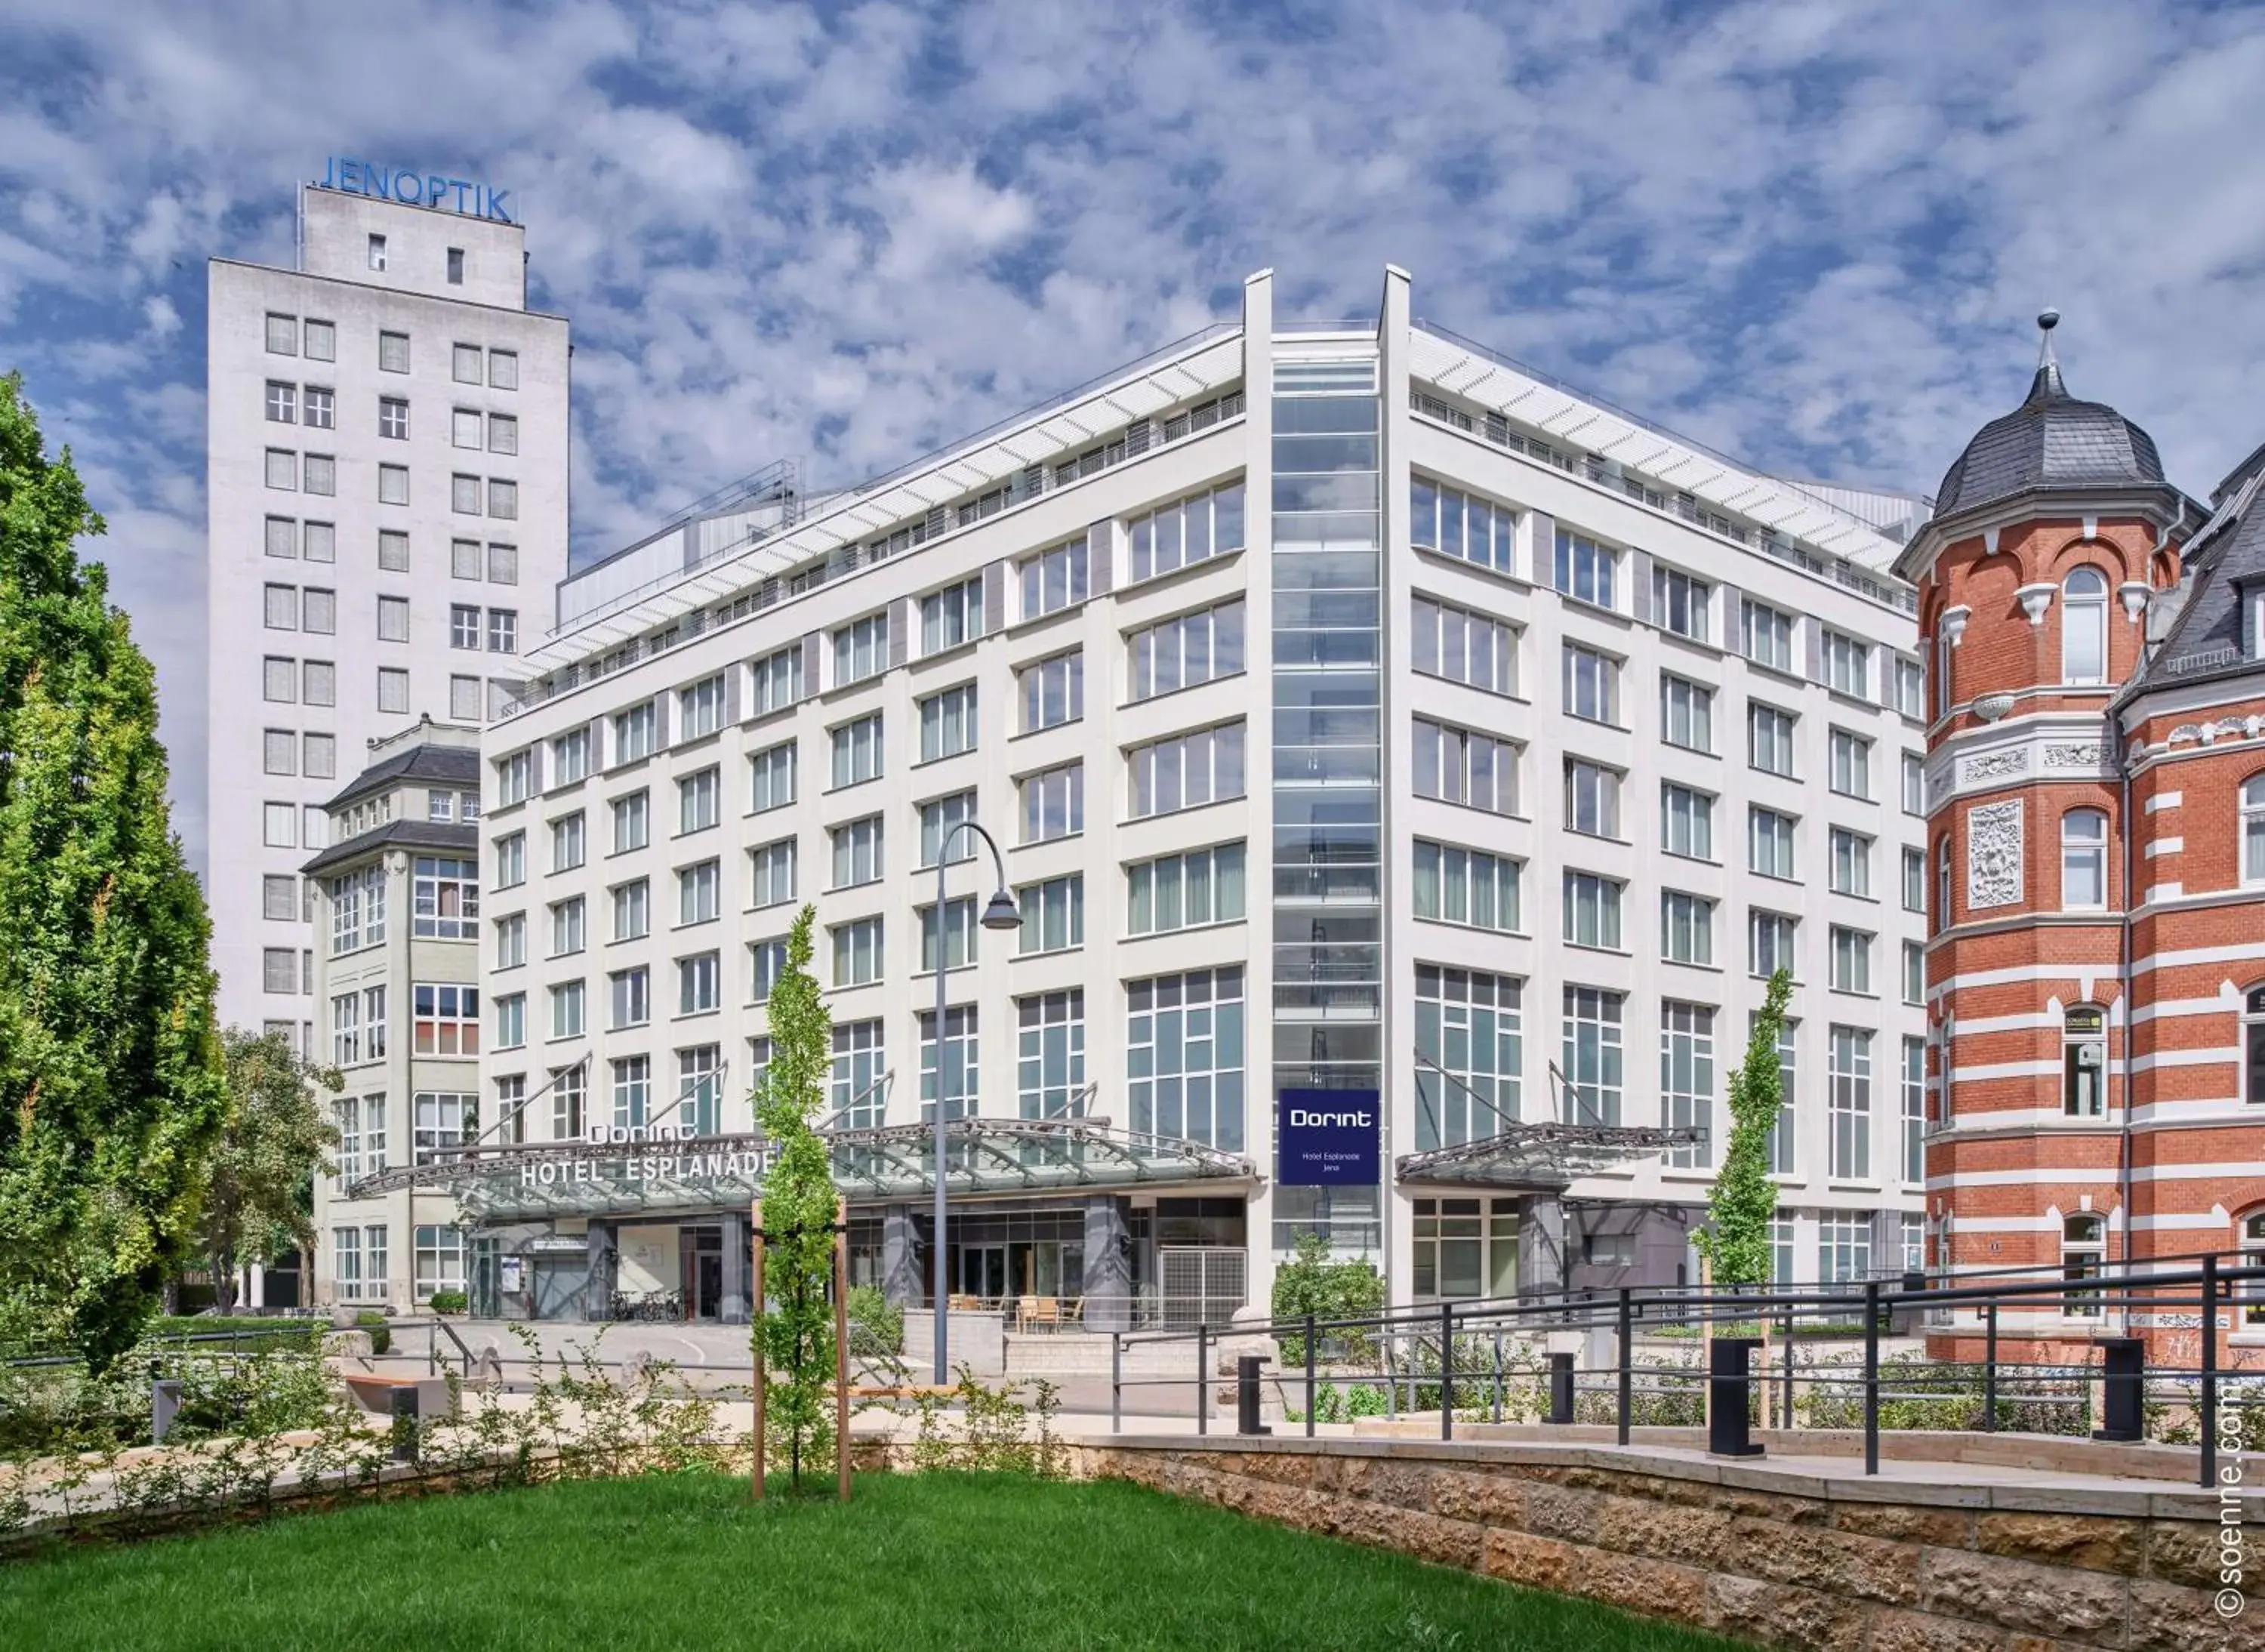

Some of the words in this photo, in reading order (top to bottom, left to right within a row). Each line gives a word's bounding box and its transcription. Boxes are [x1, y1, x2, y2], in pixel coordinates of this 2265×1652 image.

[320, 156, 512, 223] JENOPTIK
[1290, 1109, 1372, 1127] Dorint
[587, 1123, 698, 1145] Dorint
[1302, 1151, 1322, 1160] Hotel
[522, 1160, 602, 1186] HOTEL
[627, 1150, 776, 1181] ESPLANADE
